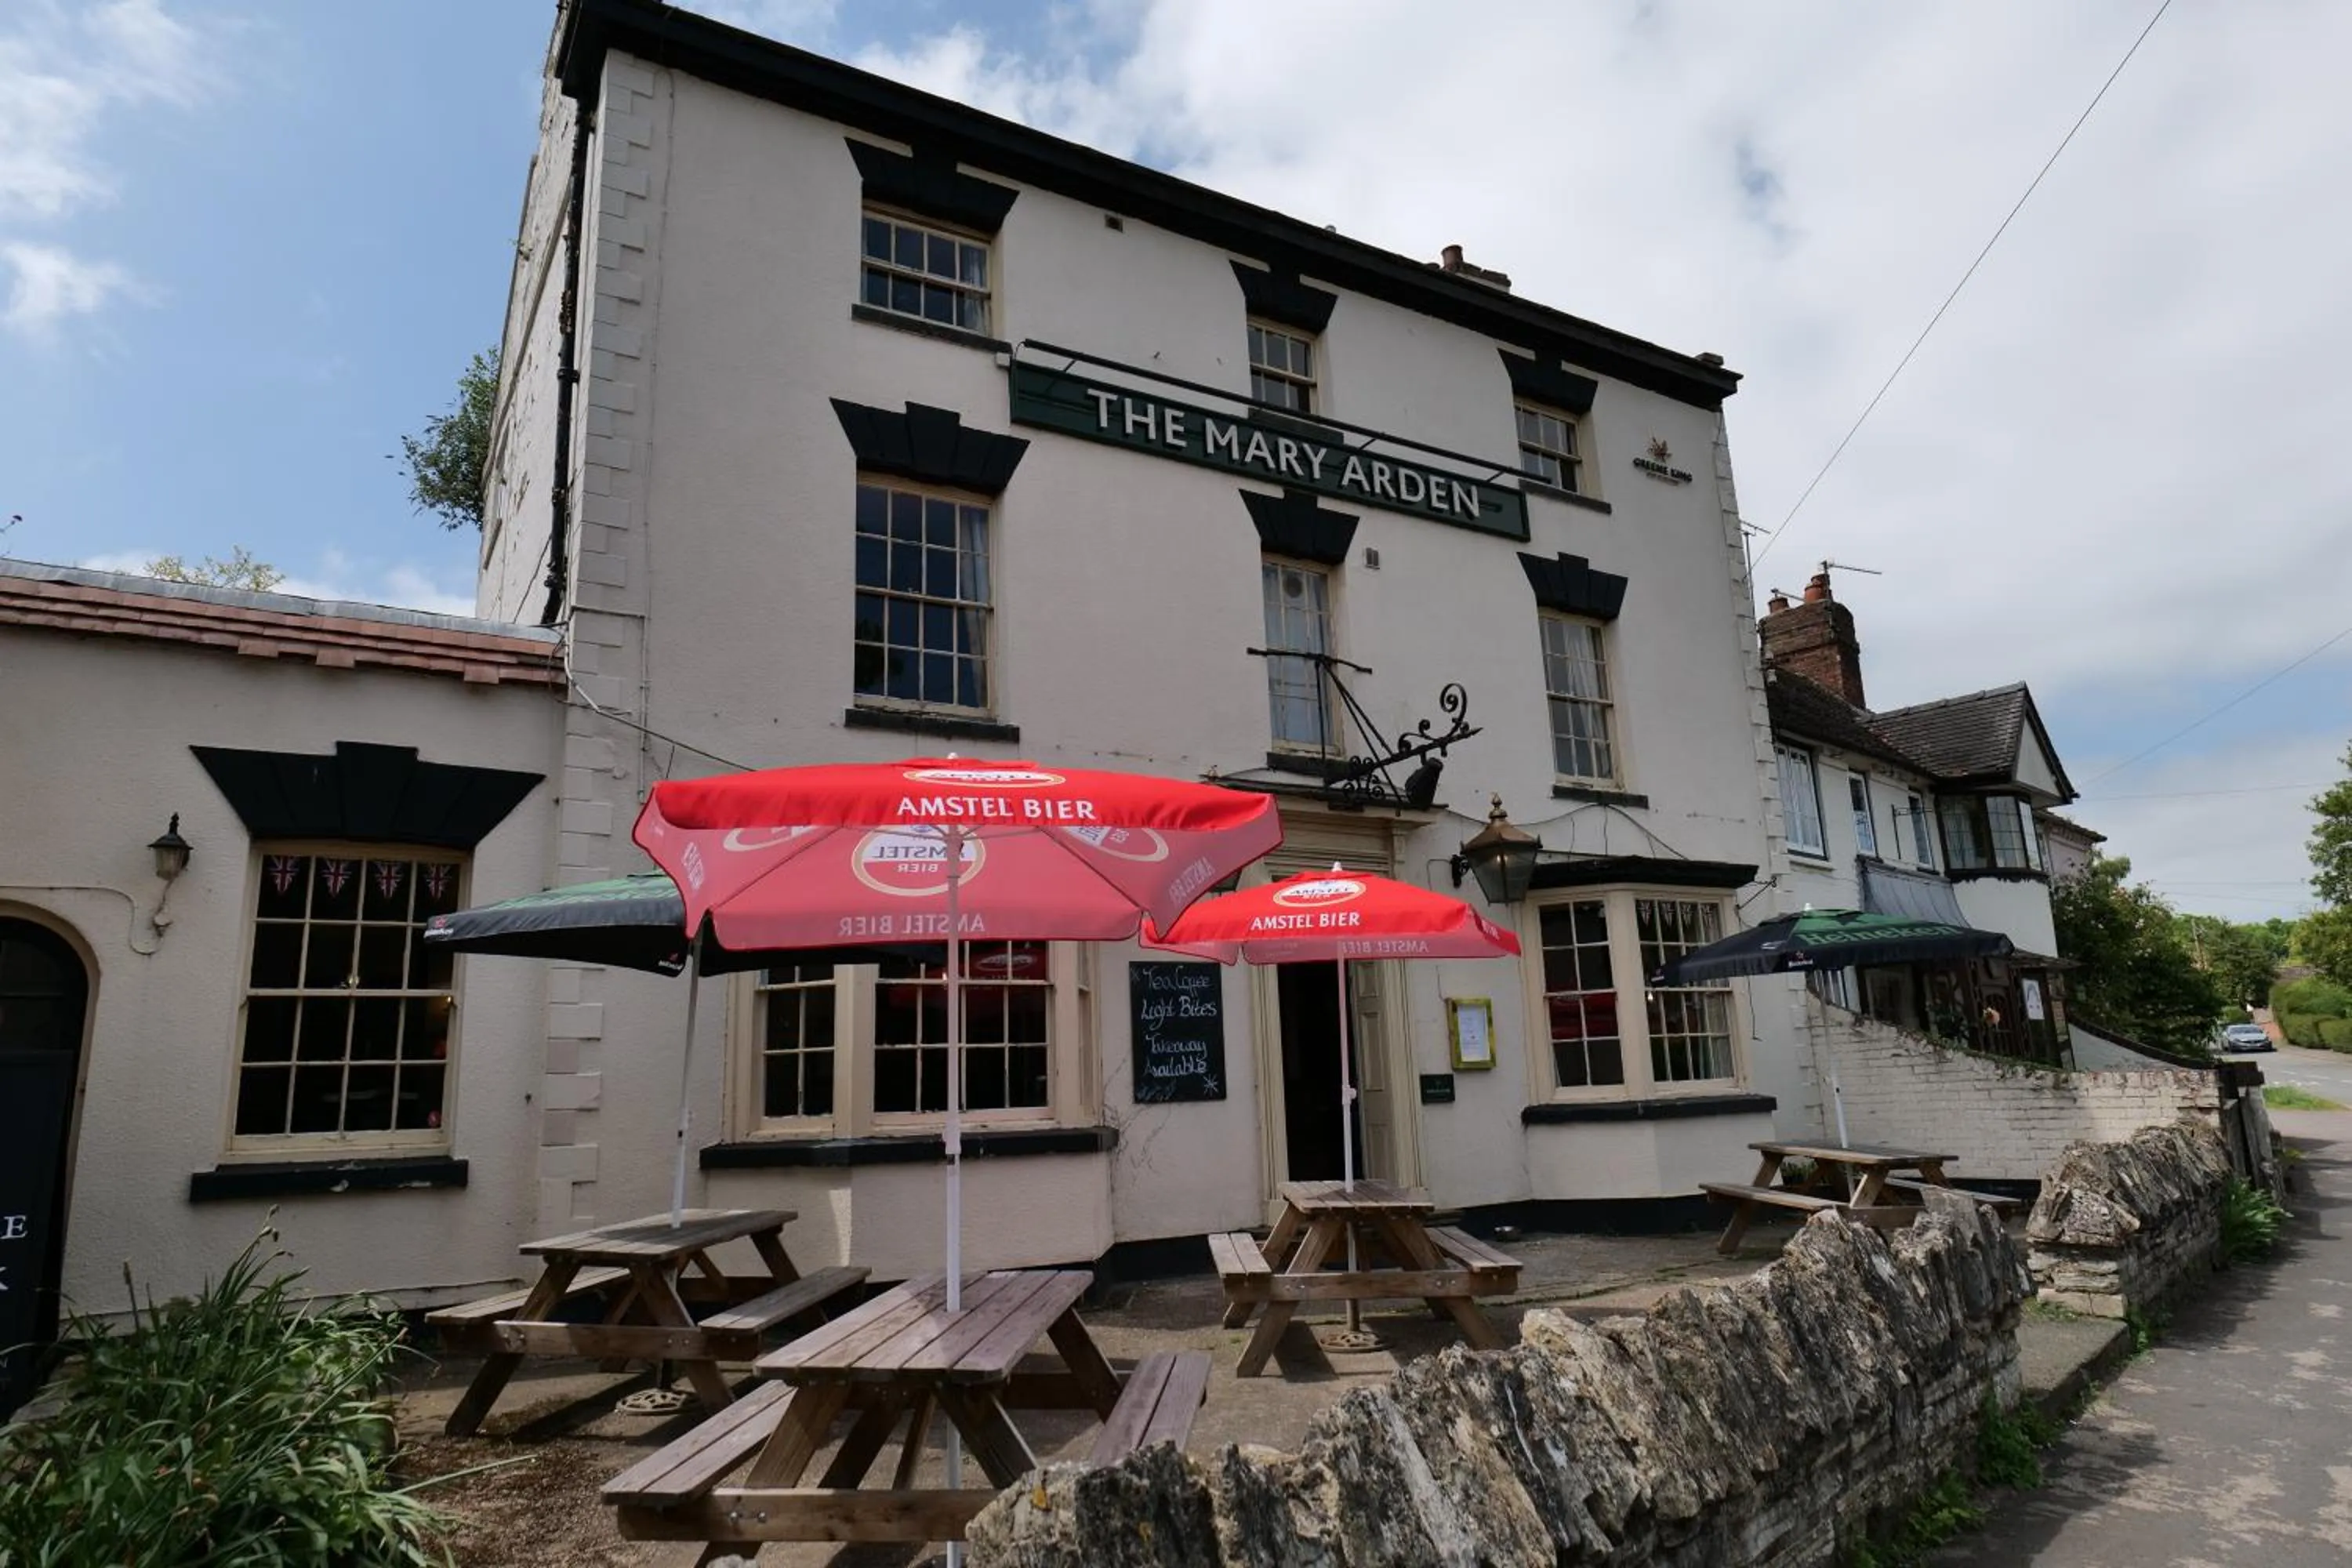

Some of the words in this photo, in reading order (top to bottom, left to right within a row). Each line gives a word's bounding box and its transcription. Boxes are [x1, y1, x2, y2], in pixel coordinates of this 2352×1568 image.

[1087, 389, 1187, 448] THE
[1205, 418, 1327, 480] MARY
[1341, 456, 1480, 518] ARDEN
[1632, 458, 1669, 475] GREENE
[1670, 467, 1693, 483] KING
[897, 797, 1013, 816] AMSTEL
[1023, 799, 1096, 819] BIER
[1250, 914, 1313, 931] AMSTEL
[1319, 912, 1360, 927] BIER
[1796, 924, 1964, 946] Heineken
[1142, 996, 1175, 1030] Light
[1178, 995, 1217, 1017] Bites
